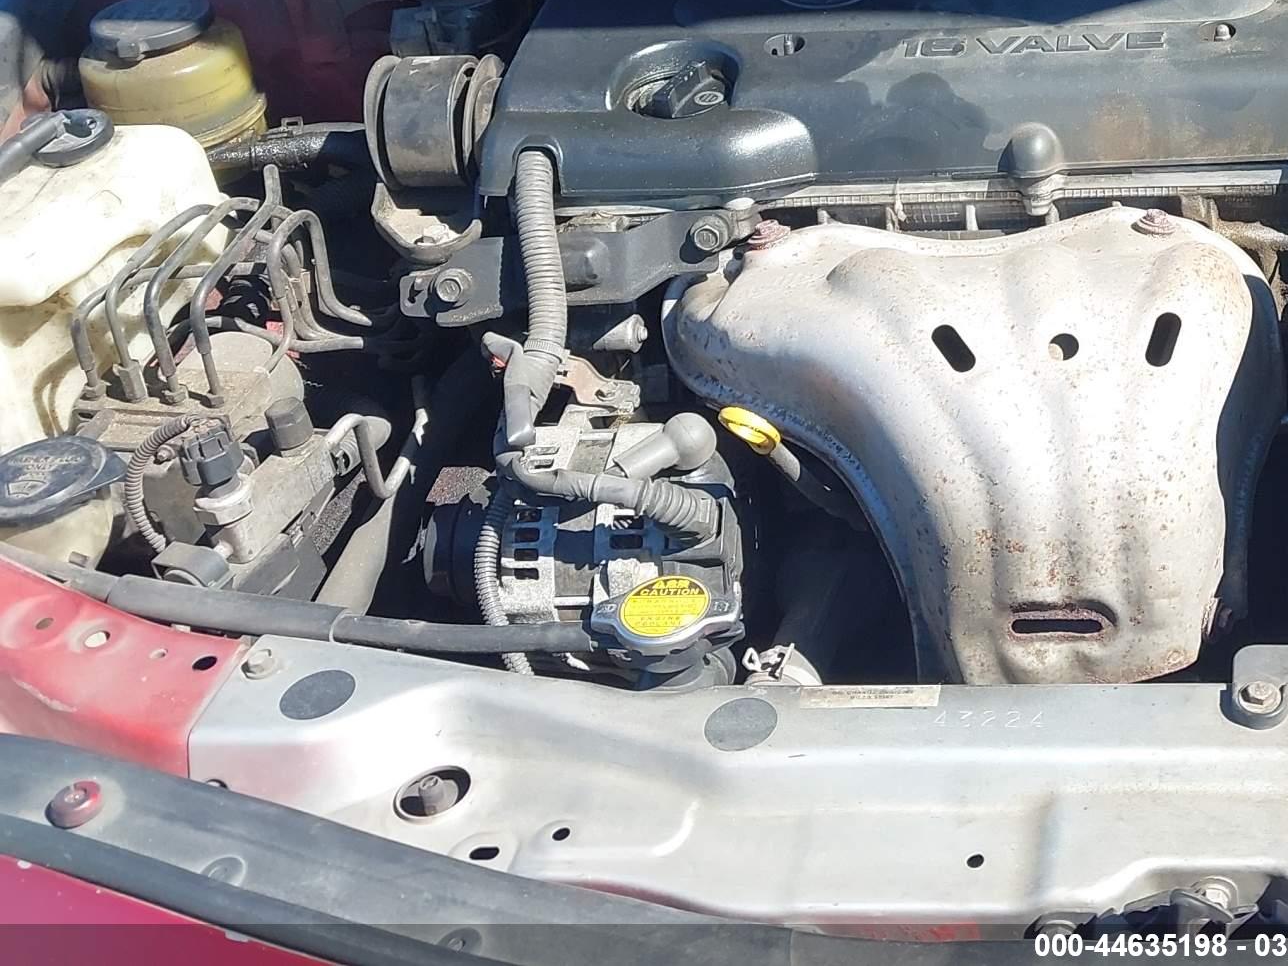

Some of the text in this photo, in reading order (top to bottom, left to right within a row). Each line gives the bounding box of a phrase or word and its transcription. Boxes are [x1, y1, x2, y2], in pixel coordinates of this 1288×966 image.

[902, 31, 1166, 58] 16 VALVE
[640, 587, 700, 596] CAUTION
